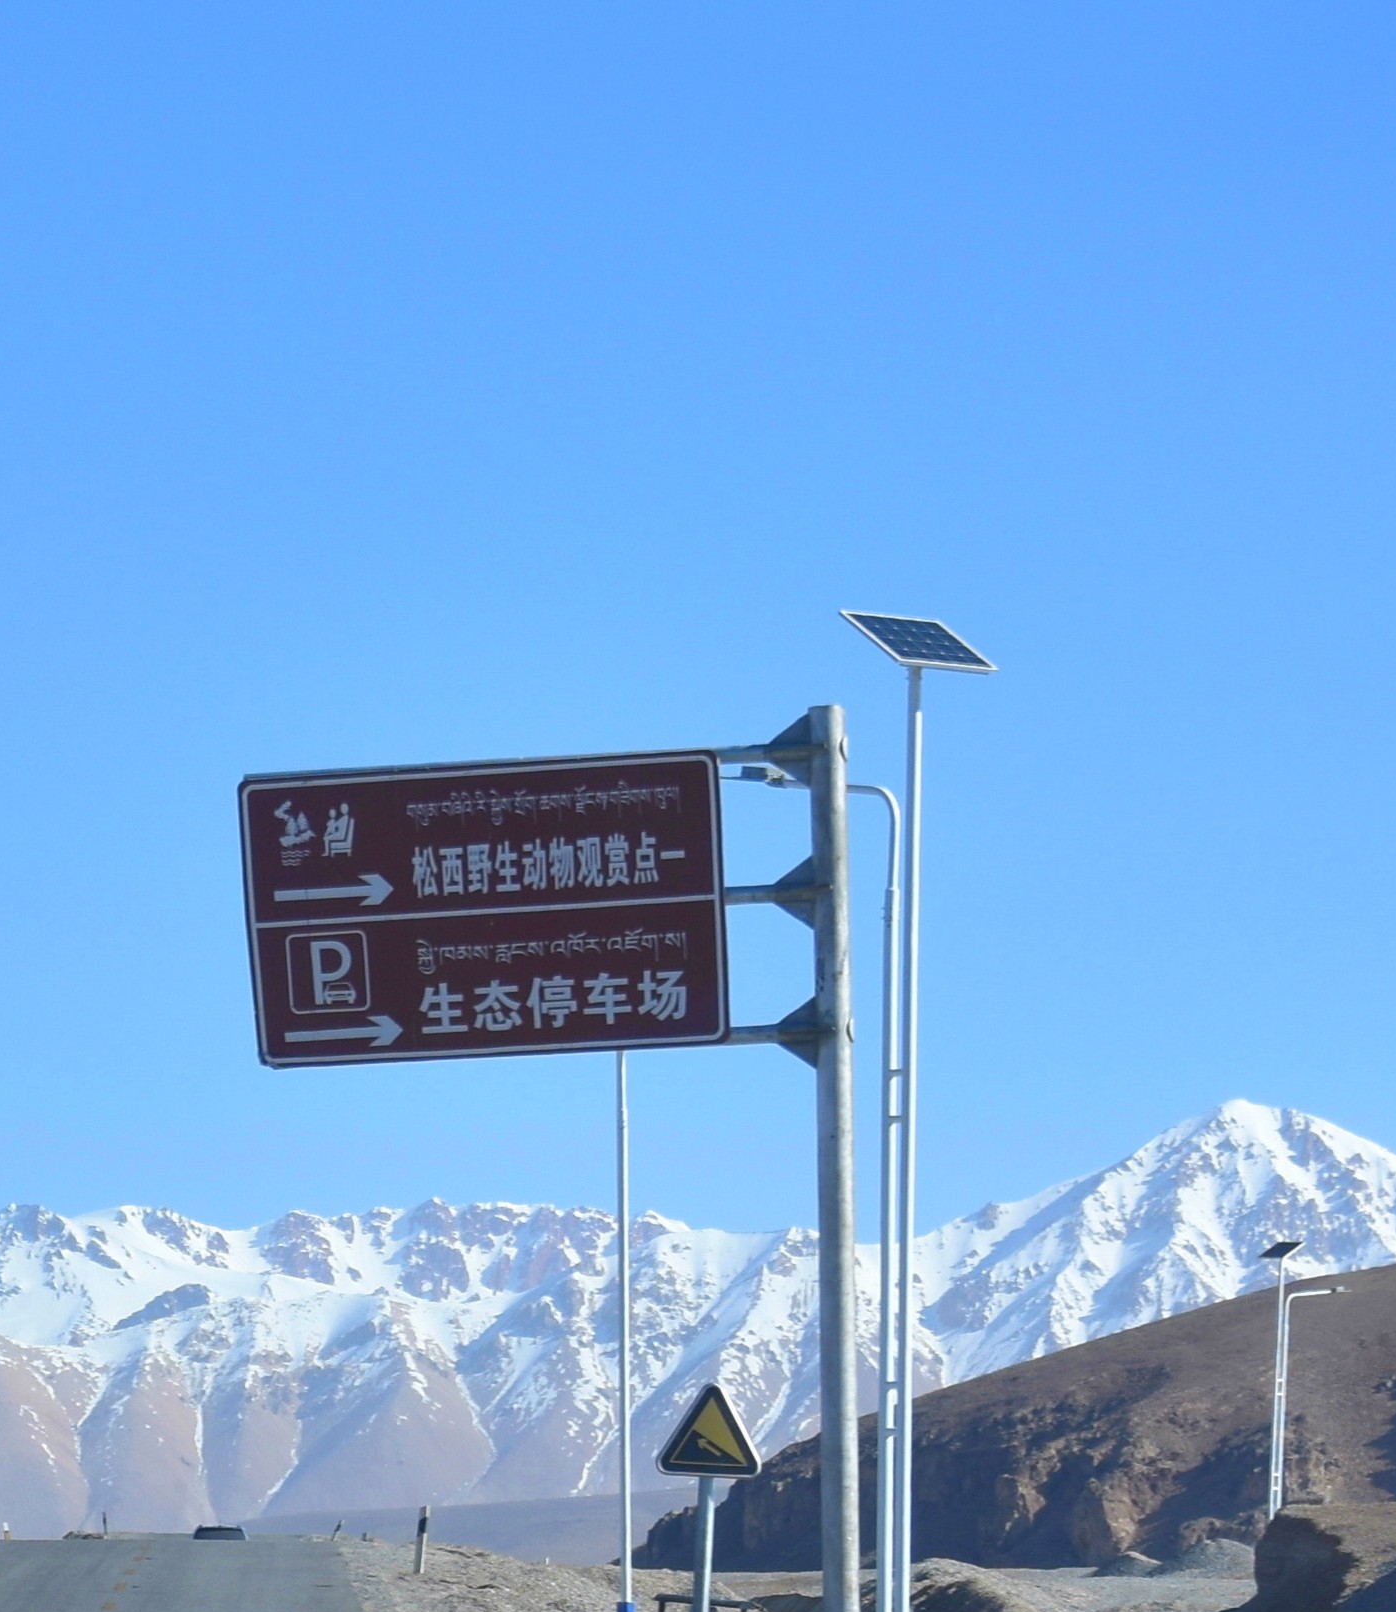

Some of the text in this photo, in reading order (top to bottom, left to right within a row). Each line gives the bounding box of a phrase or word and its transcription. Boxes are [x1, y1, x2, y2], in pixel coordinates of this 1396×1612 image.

[411, 831, 686, 899] 松西野生动物观赏点一
[309, 940, 353, 1006] P
[418, 969, 688, 1035] 生态停车场
